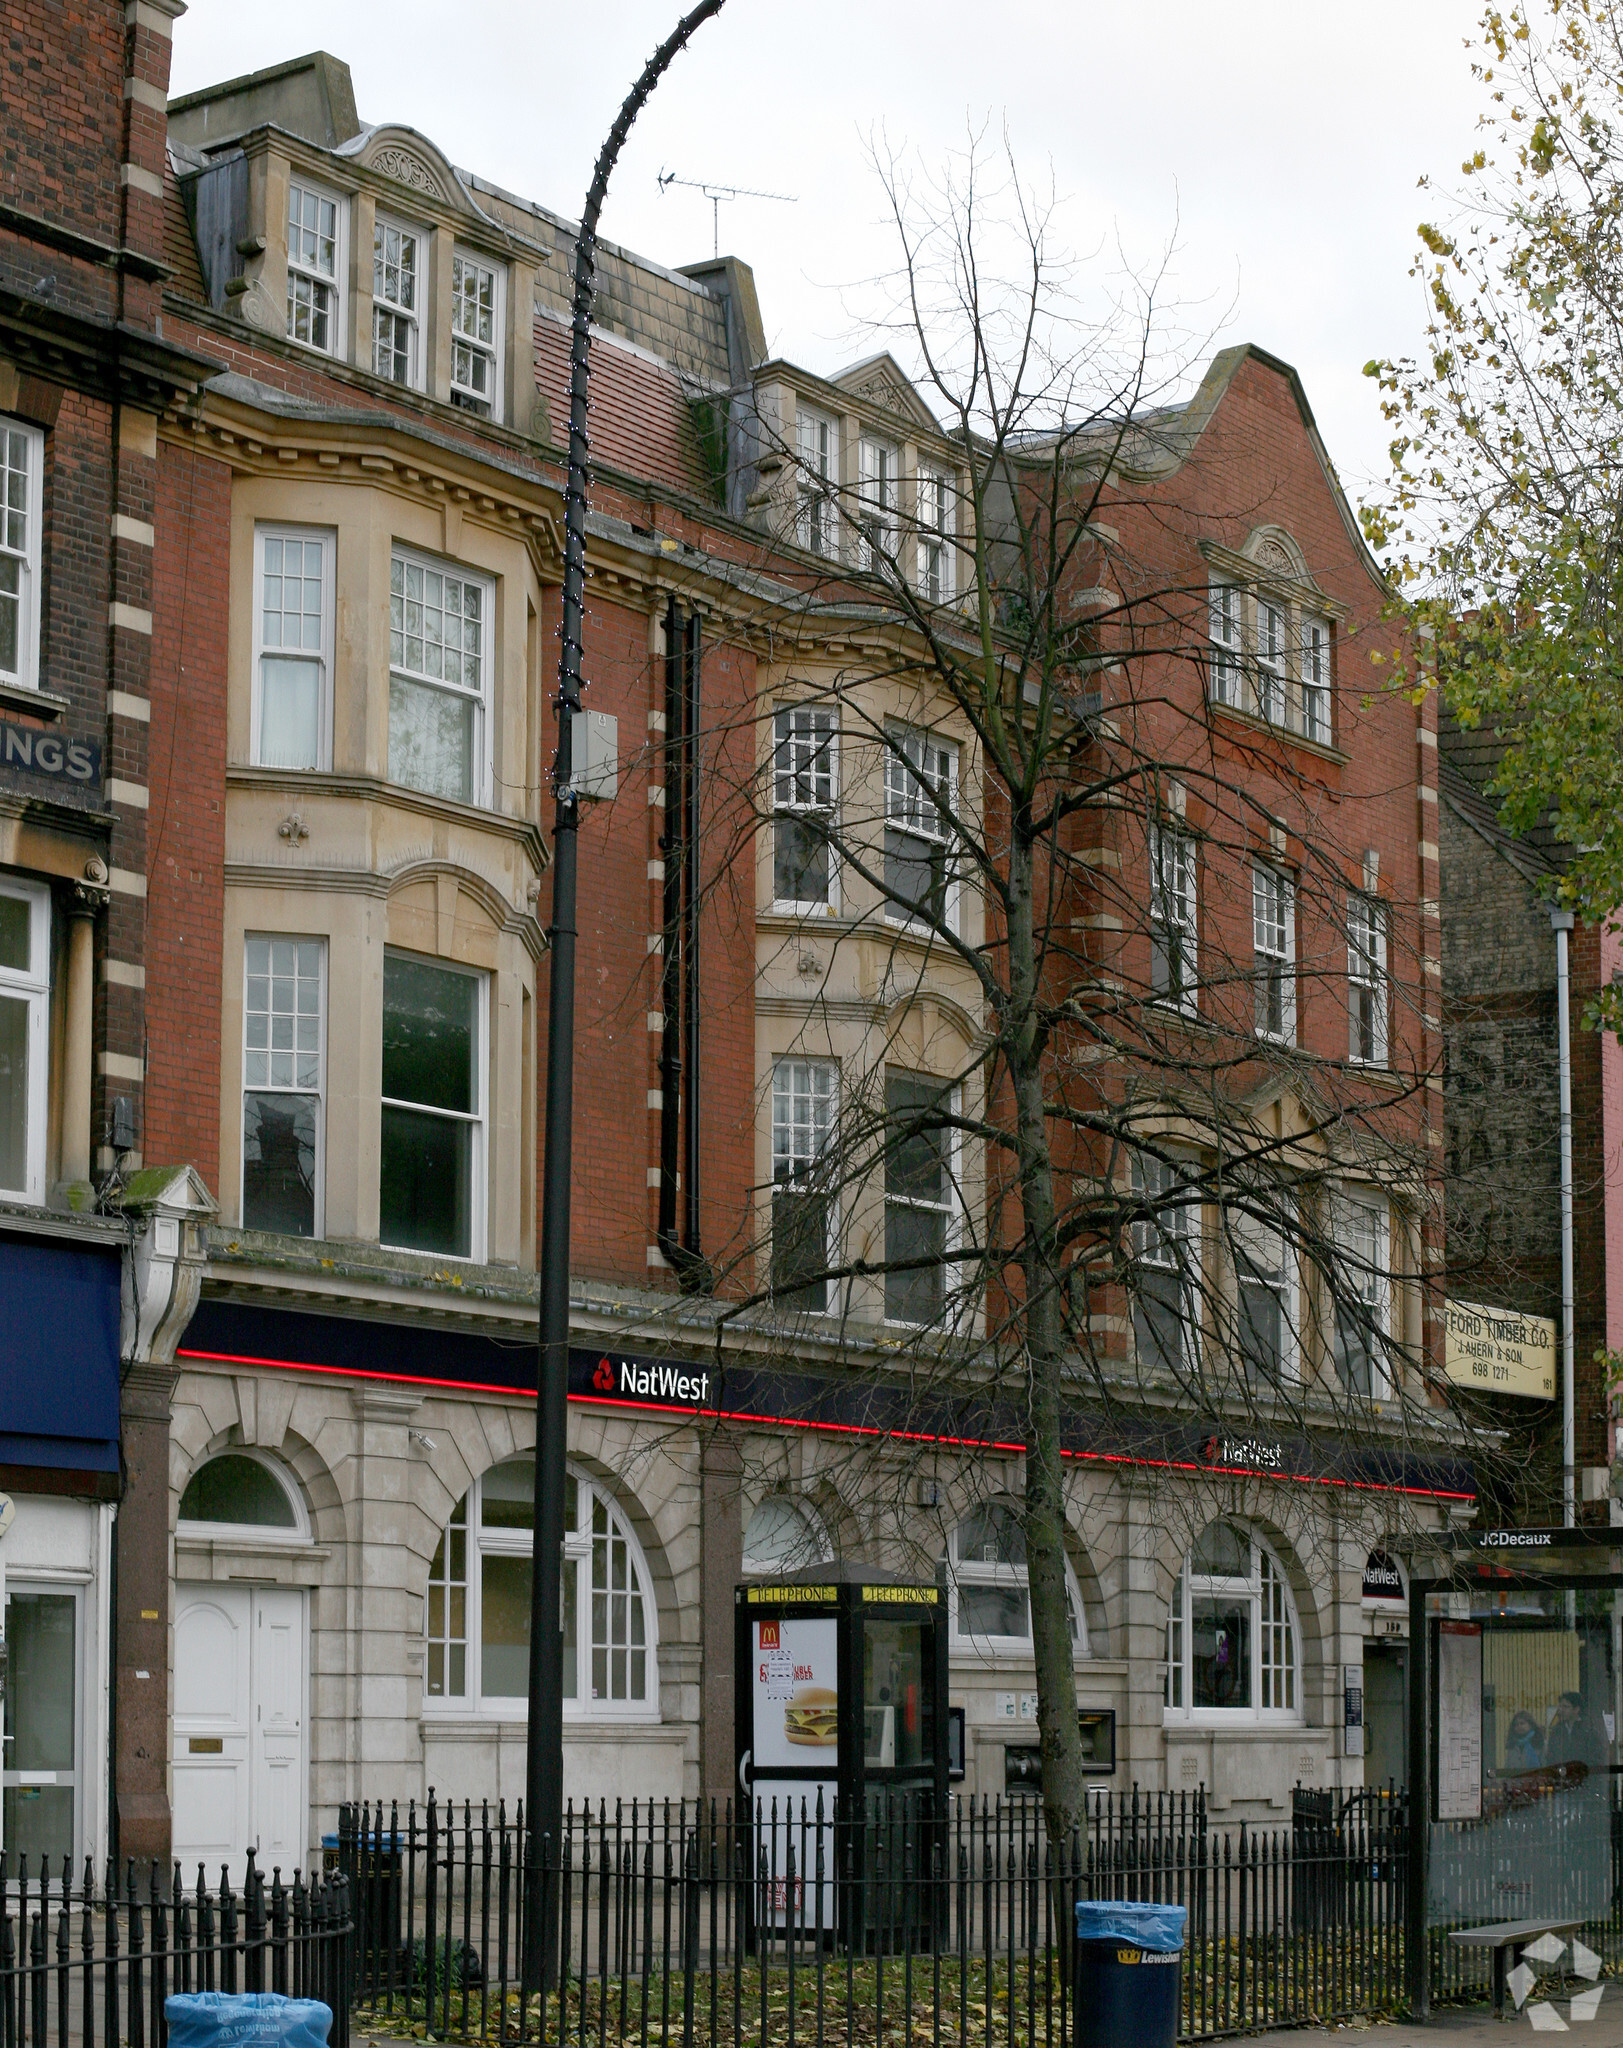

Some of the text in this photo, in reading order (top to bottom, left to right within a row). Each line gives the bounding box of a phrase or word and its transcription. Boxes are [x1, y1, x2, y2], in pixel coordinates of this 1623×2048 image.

[0, 727, 94, 780] NGS
[1505, 1348, 1523, 1364] SON
[1472, 1361, 1509, 1382] 698 1271
[620, 1362, 709, 1400] NatWest
[1479, 1531, 1552, 1547] JCDecaux
[1362, 1566, 1400, 1586] NatWest
[757, 1587, 828, 1602] TELEPHONE
[869, 1587, 931, 1602] TELEPHONE
